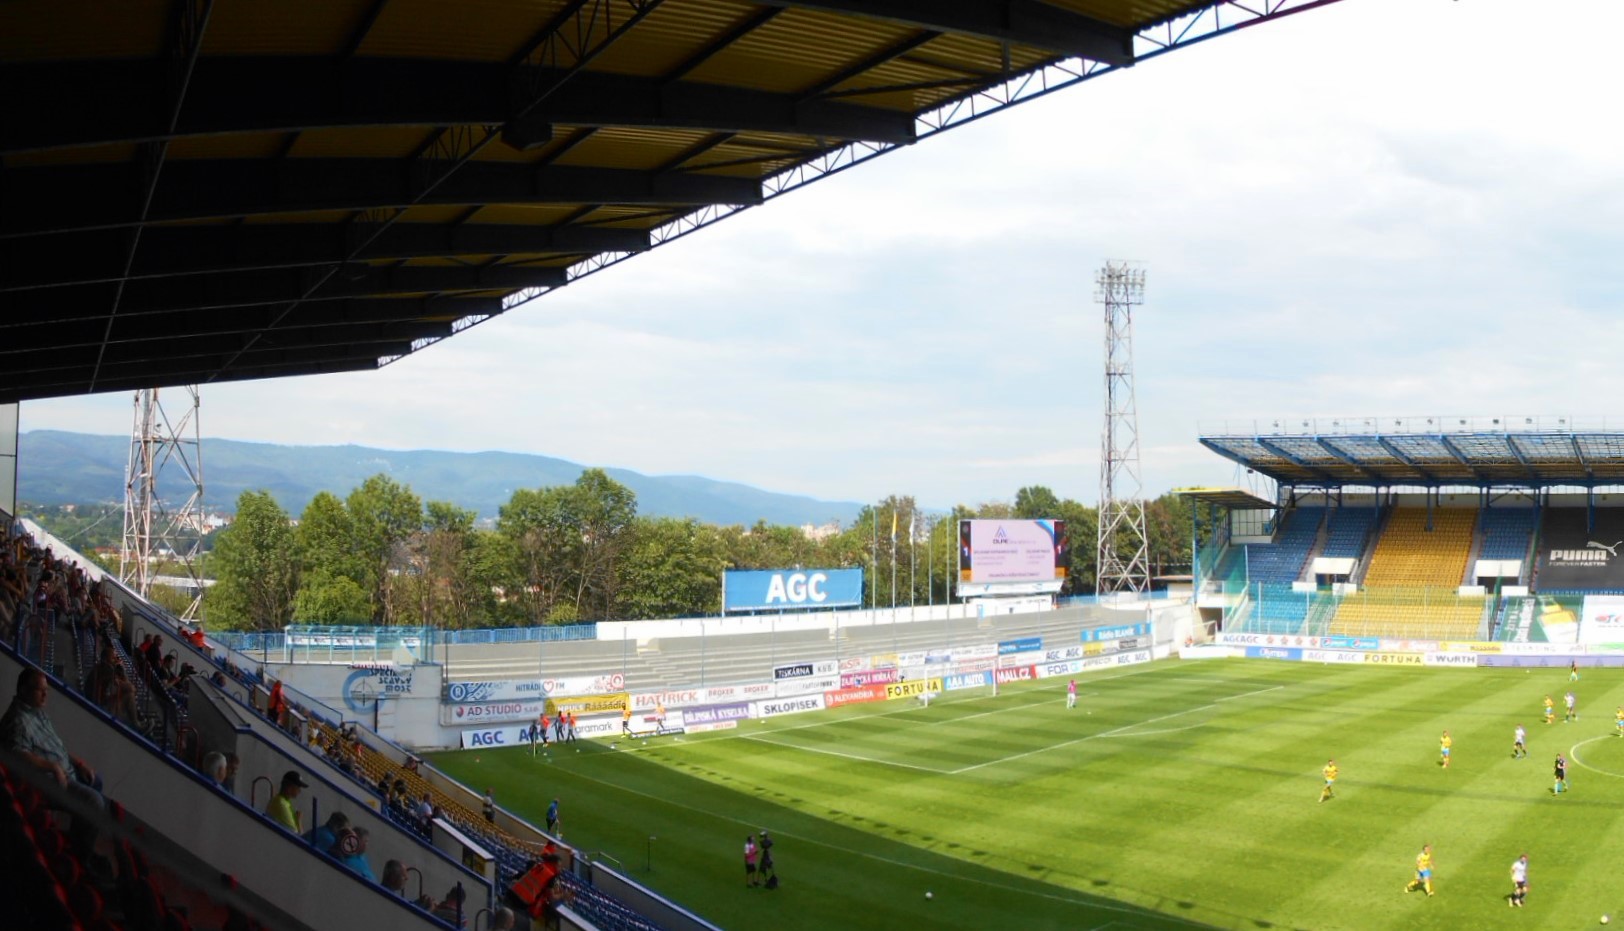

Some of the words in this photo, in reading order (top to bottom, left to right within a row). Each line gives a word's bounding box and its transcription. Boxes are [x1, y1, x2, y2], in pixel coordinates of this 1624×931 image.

[1550, 550, 1607, 560] PUMA
[765, 573, 827, 603] AGC
[1046, 650, 1060, 660] AGC
[1066, 647, 1079, 657] AGC
[1364, 654, 1421, 663] FORTUNA
[636, 690, 697, 707] HATTRICK
[467, 706, 482, 716] AD
[485, 703, 521, 715] STUDIO
[764, 699, 818, 714] SKLOPÍSEK
[472, 731, 504, 746] AGC
